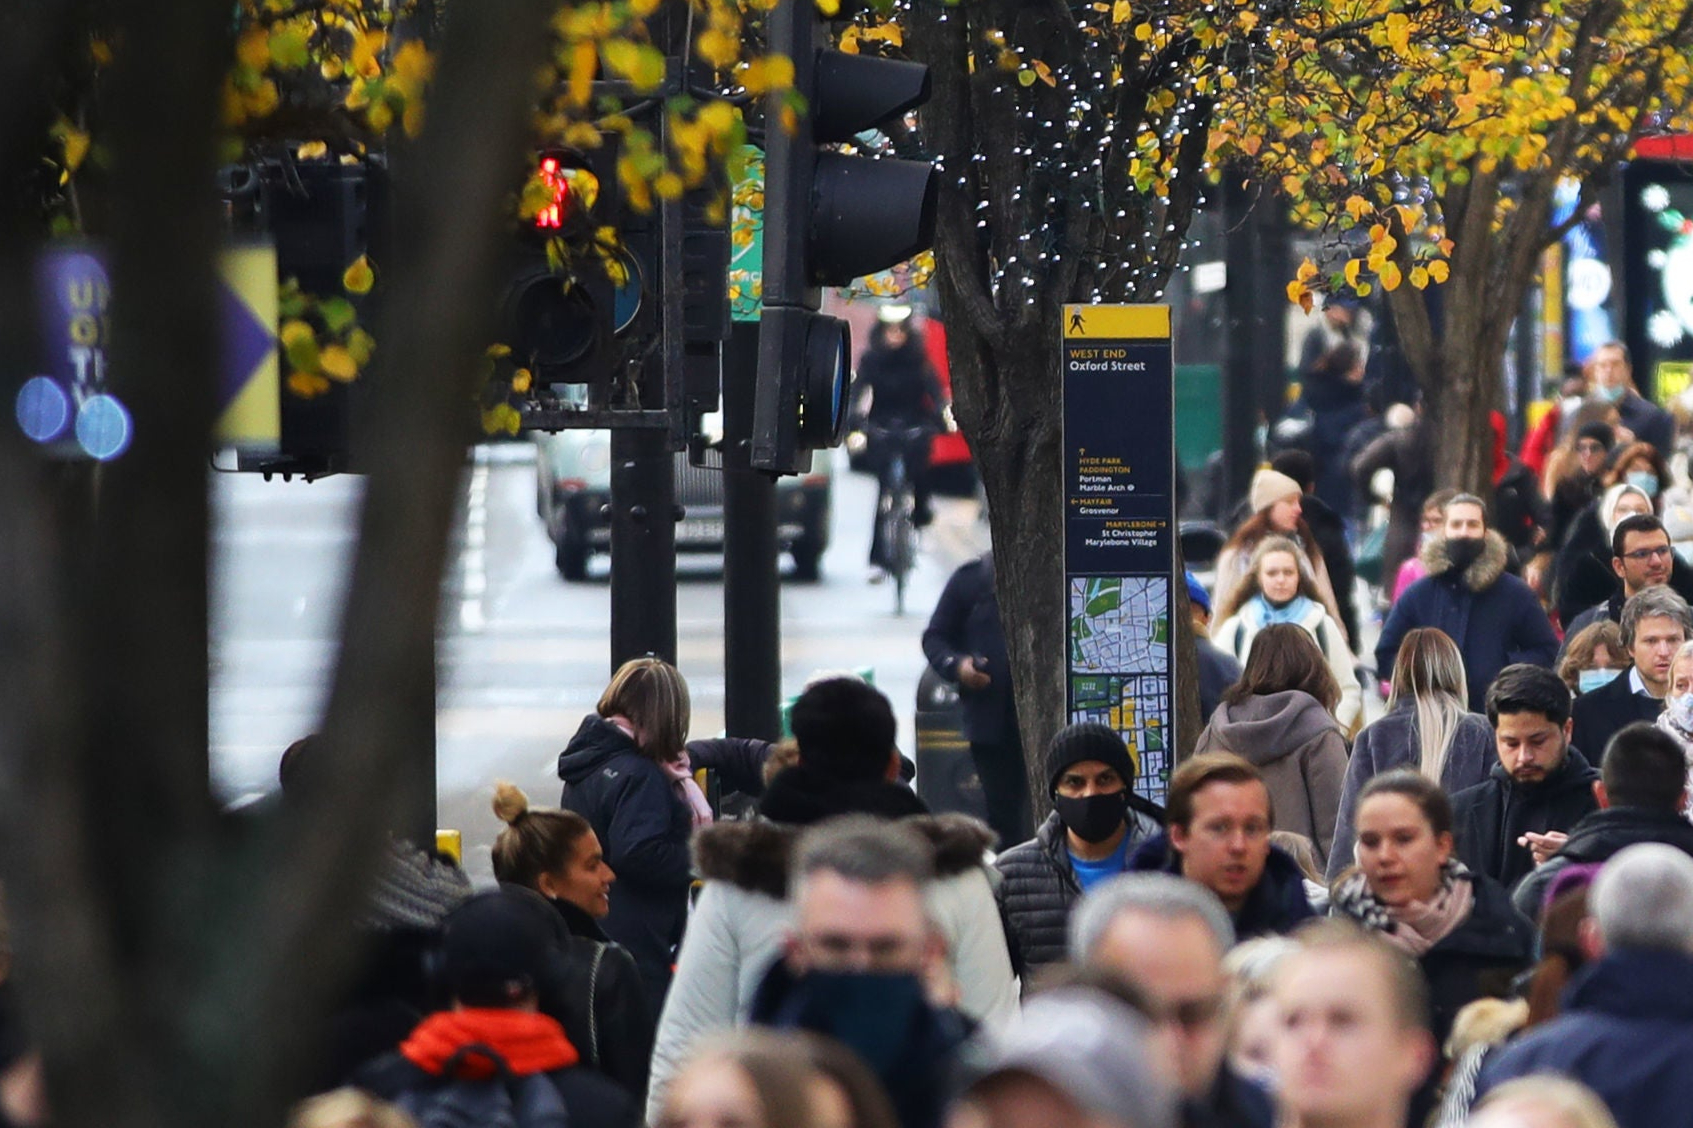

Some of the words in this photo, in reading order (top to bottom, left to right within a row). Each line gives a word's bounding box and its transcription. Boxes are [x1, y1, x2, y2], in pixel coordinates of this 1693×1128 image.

[1069, 349, 1099, 358] WEST
[1103, 349, 1127, 358] END
[1069, 360, 1108, 371] Oxford
[1111, 360, 1146, 371] Street
[1079, 466, 1131, 474] PADDINGTON
[1079, 475, 1112, 483] Portman
[1079, 484, 1106, 492] Marble
[1107, 484, 1126, 492] Arch
[1079, 506, 1119, 514] Grosvenor
[1101, 529, 1110, 537] St
[1111, 529, 1157, 538] Christopher
[1085, 538, 1130, 547] Marylebone
[1131, 538, 1158, 547] Village
